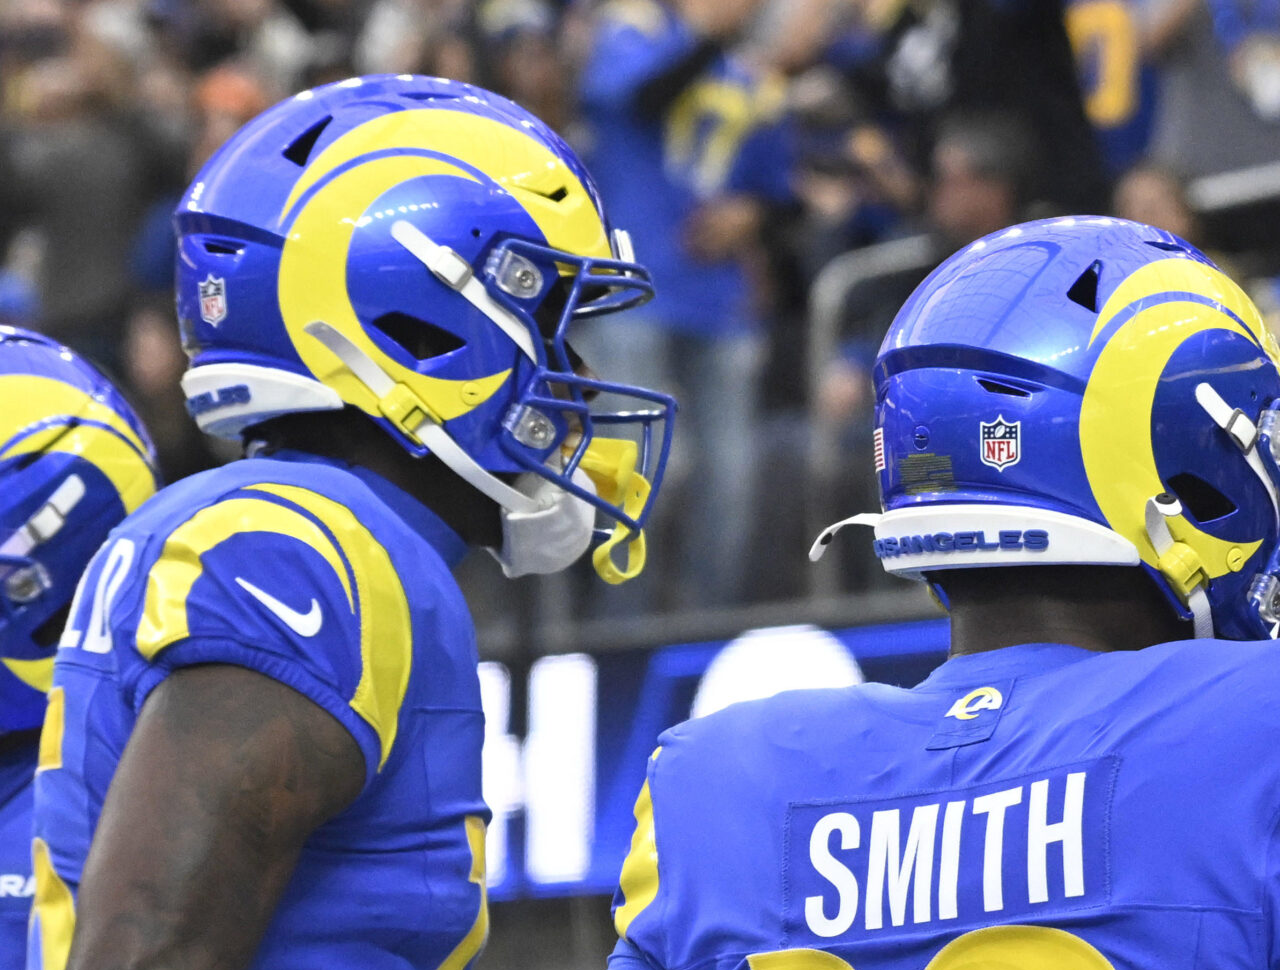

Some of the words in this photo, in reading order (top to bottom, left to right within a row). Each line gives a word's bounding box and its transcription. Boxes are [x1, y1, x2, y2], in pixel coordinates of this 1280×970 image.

[985, 440, 1015, 463] NFL
[899, 528, 1050, 556] ANGELES
[804, 772, 1087, 937] SMITH
